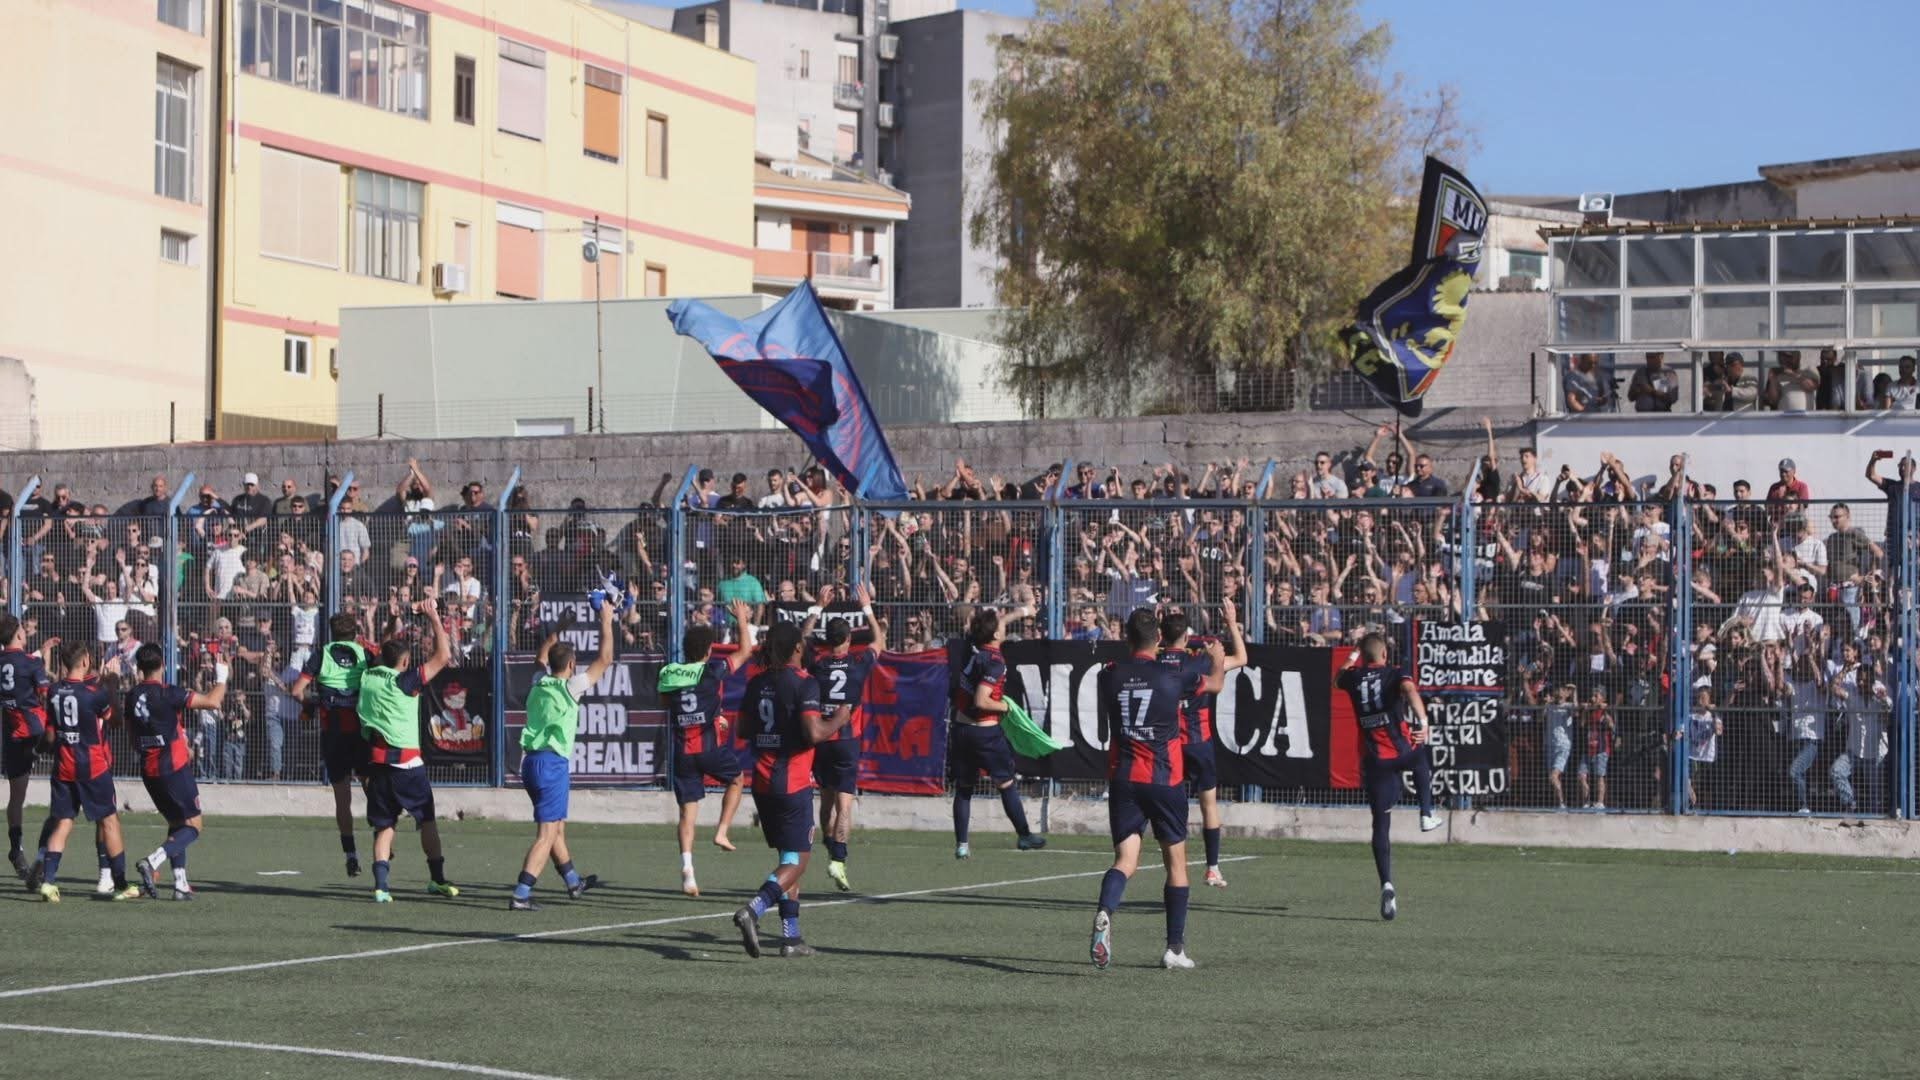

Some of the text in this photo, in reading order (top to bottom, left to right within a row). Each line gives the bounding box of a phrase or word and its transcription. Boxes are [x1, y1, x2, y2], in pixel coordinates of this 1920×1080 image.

[1421, 621, 1486, 643] Amala
[829, 669, 848, 700] 2
[1418, 666, 1498, 687] Sempre
[50, 693, 78, 727] 19
[680, 689, 698, 713] 5
[1016, 661, 1315, 759] MOCA
[1117, 688, 1154, 727] 17
[1356, 678, 1384, 713] 11
[575, 703, 627, 736] ORD
[758, 698, 775, 733] 9
[1432, 745, 1456, 767] DI
[1402, 767, 1506, 796] ESERLO
